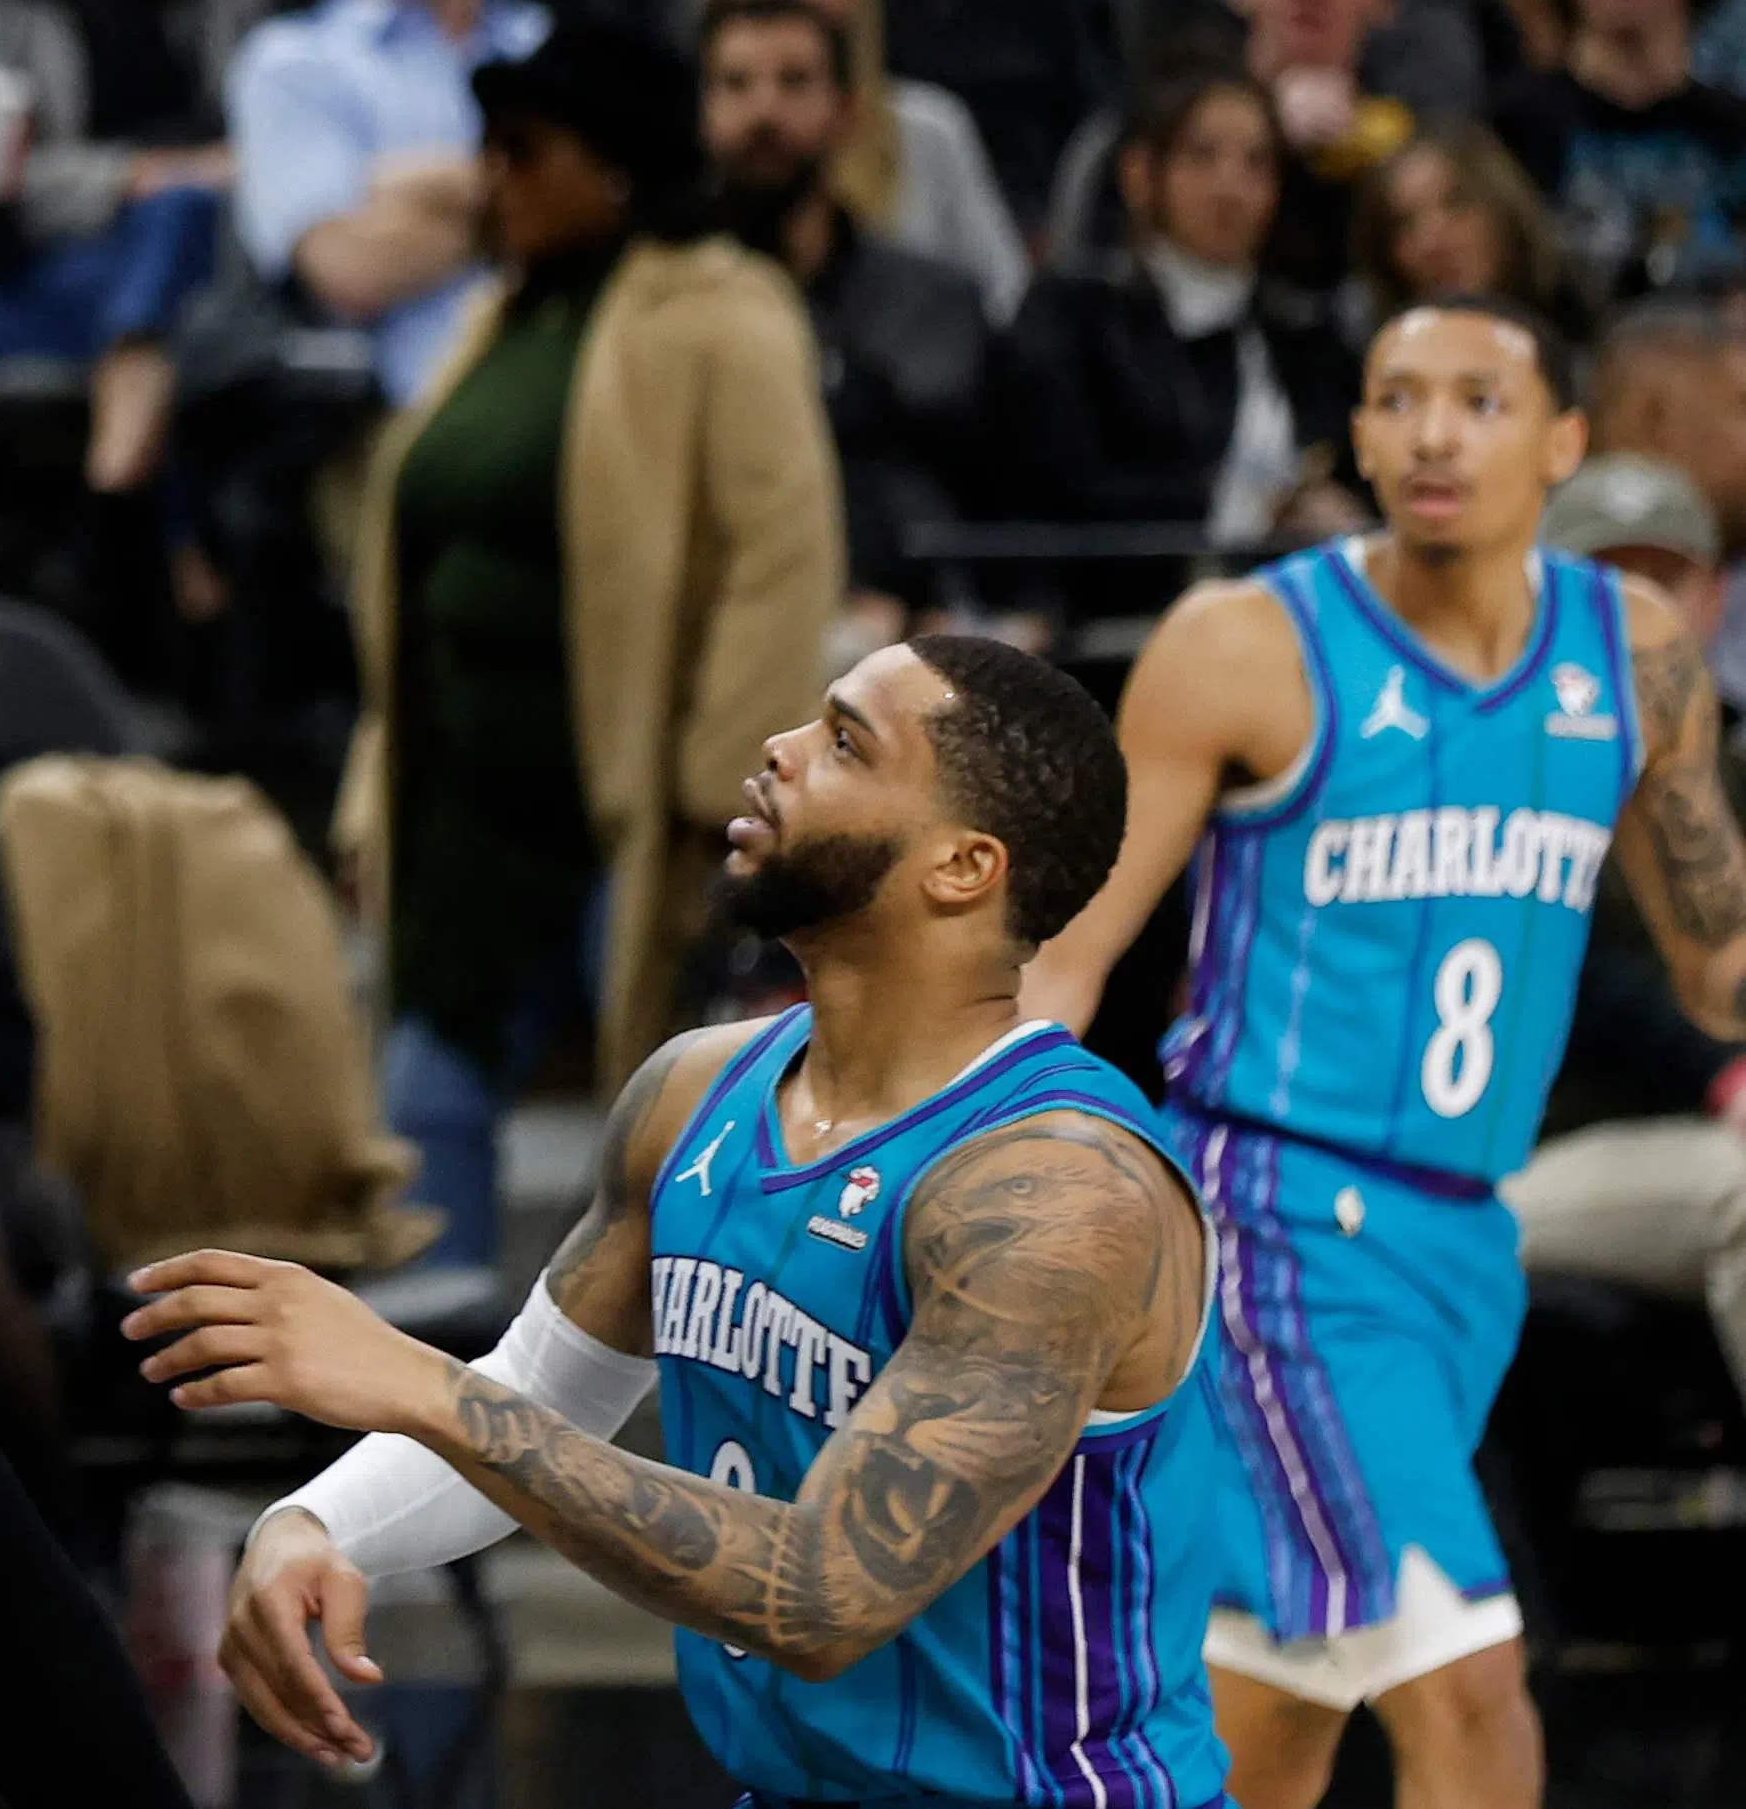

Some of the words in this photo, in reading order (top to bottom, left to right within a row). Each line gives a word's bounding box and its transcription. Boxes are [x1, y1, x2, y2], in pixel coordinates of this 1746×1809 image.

[1302, 802, 1613, 915] CHARLOTT
[1419, 935, 1504, 1120] 8
[651, 1255, 872, 1431] HARLOTTE
